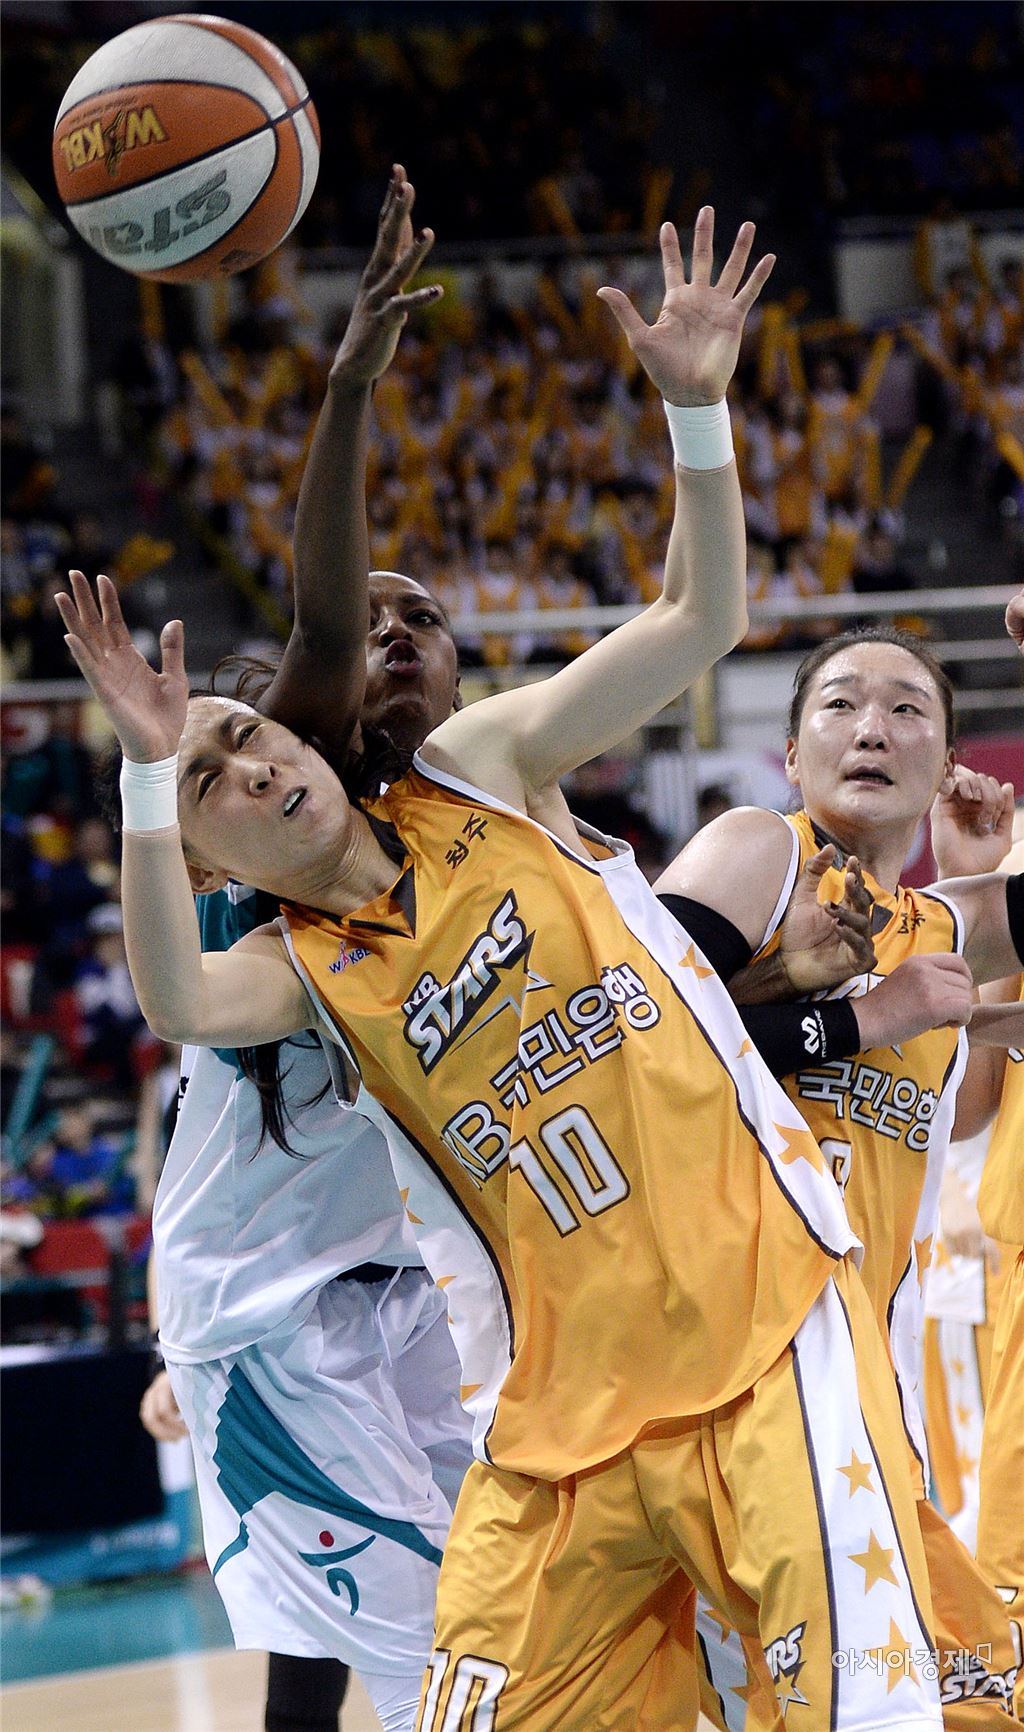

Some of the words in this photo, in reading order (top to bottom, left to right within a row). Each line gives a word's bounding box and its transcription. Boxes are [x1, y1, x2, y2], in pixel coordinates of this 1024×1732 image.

[404, 888, 527, 1076] STARS
[509, 1104, 631, 1238] 10
[419, 1647, 511, 1732] 10
